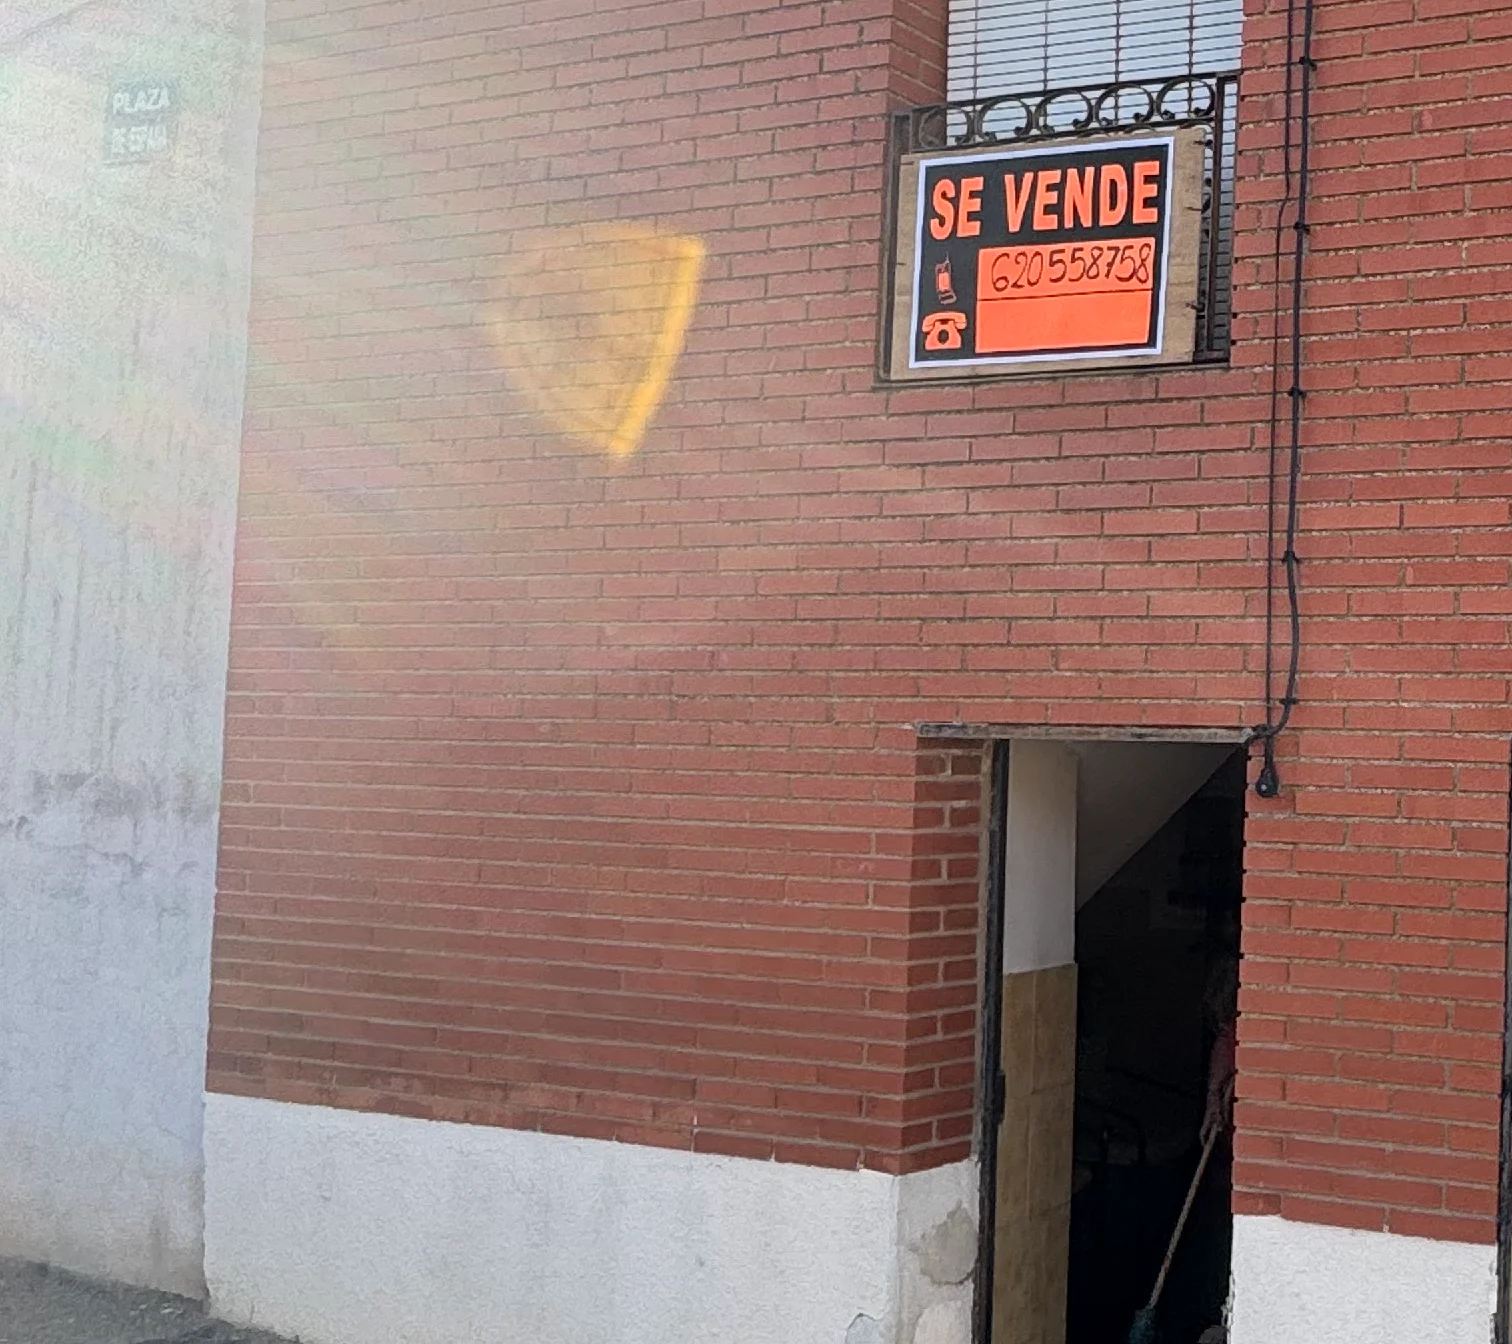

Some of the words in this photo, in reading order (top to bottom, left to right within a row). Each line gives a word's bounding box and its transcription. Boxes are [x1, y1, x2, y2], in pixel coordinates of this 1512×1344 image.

[112, 87, 171, 114] PLAZA
[929, 175, 984, 240] SE
[1004, 160, 1160, 234] VENDE
[991, 242, 1152, 293] 620558758
